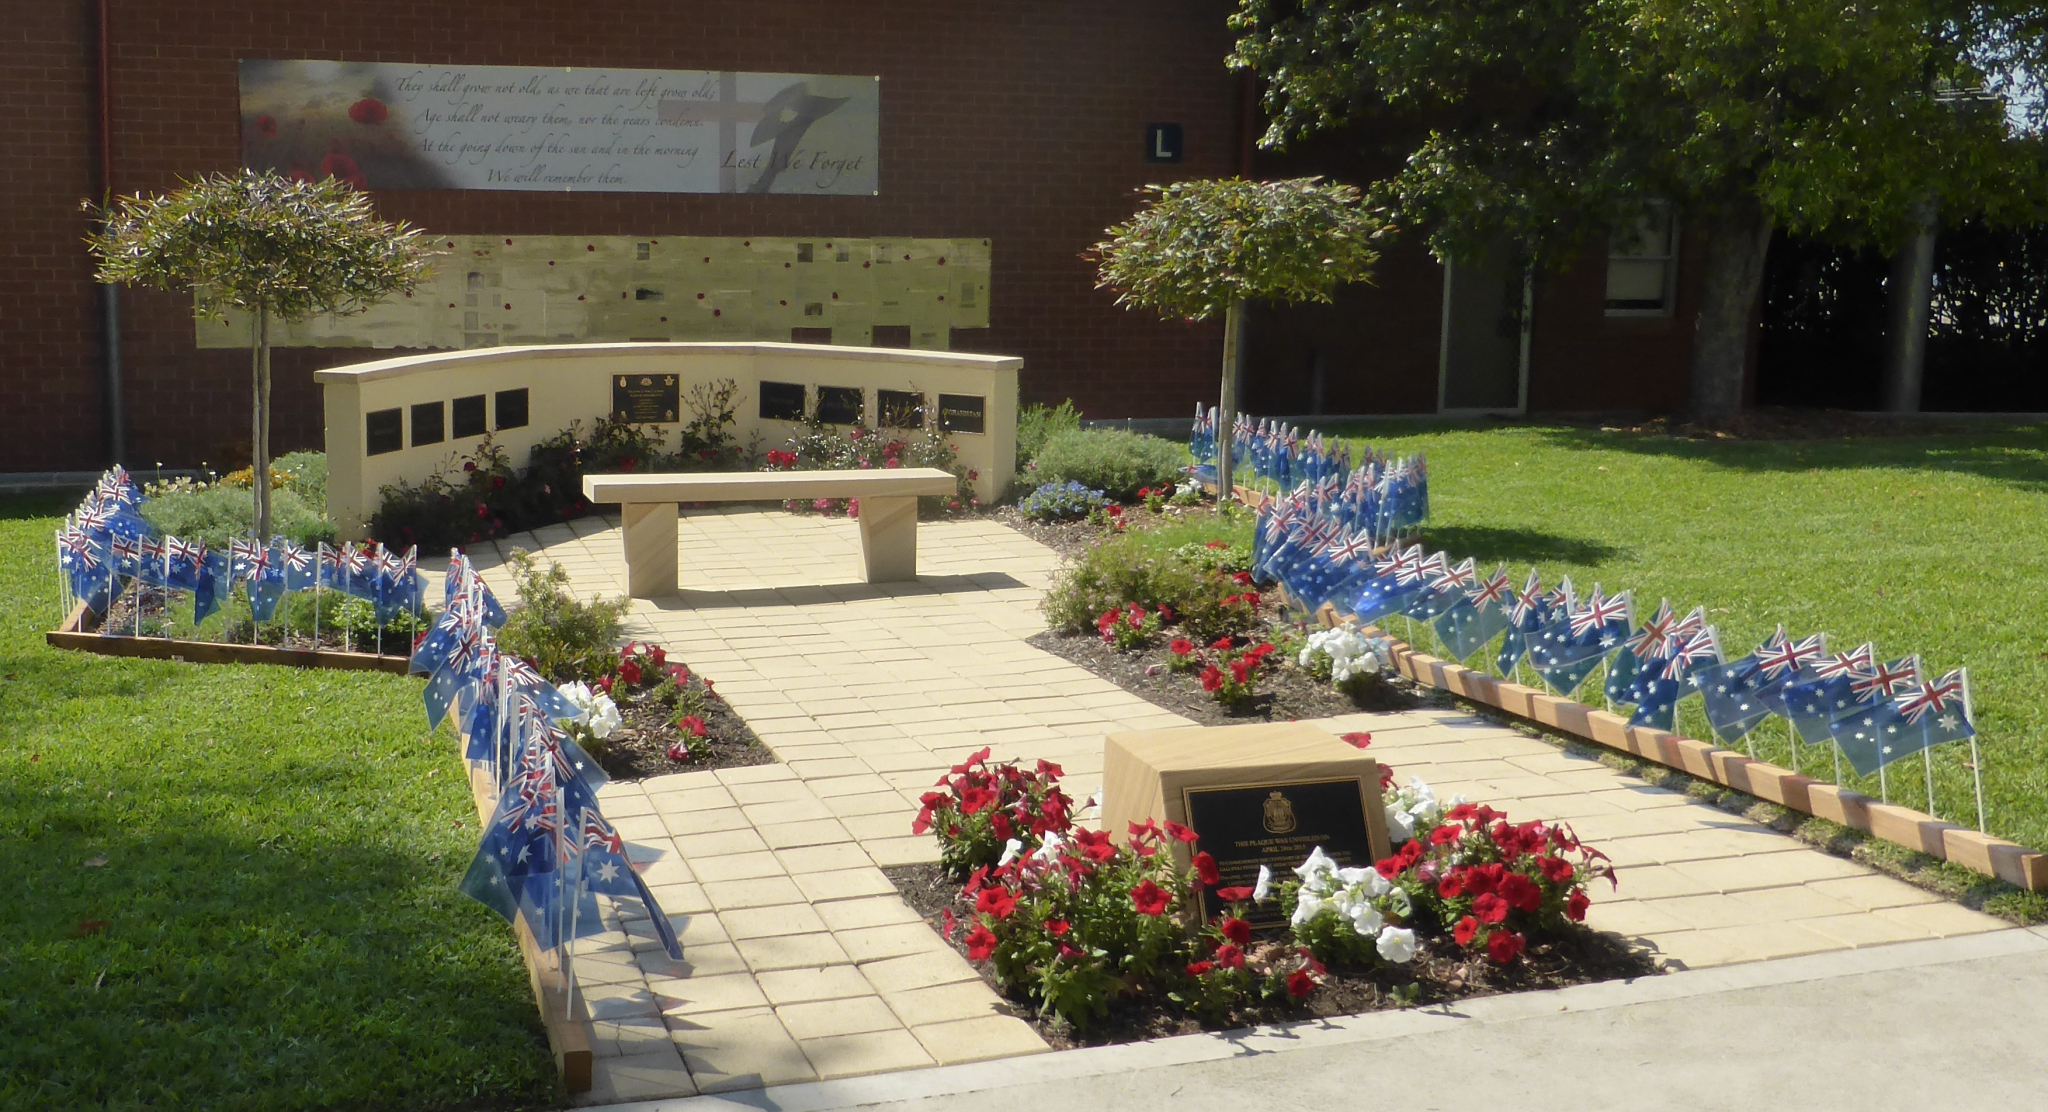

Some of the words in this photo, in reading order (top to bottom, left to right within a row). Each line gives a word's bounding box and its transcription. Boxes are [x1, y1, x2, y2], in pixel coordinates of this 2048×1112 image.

[396, 71, 423, 101] They
[428, 72, 466, 93] shall
[448, 84, 491, 105] grow
[495, 82, 515, 94] not
[519, 75, 547, 96] old,
[547, 86, 560, 95] as
[565, 87, 581, 96] we
[585, 75, 609, 96] that
[613, 87, 632, 96] are
[628, 77, 662, 111] left
[647, 89, 687, 109] grow
[692, 80, 719, 99] old;
[414, 108, 441, 134] Age
[445, 102, 483, 123] shall
[480, 113, 500, 123] not
[542, 103, 572, 126] them,
[578, 117, 597, 125] nor
[601, 105, 624, 125] the
[655, 108, 703, 127] condemn.
[504, 116, 538, 133] weary
[612, 117, 650, 135] years
[417, 138, 434, 151] At
[438, 132, 460, 151] the
[495, 134, 525, 154] down
[519, 133, 554, 167] of
[547, 133, 570, 154] the
[570, 146, 587, 154] sun
[591, 136, 622, 155] and
[617, 145, 628, 155] in
[633, 135, 655, 155] the
[1156, 129, 1172, 157] L
[445, 142, 492, 165] going
[654, 148, 699, 168] morning
[487, 168, 512, 183] We
[514, 164, 546, 183] will
[543, 165, 591, 183] remember
[598, 164, 627, 183] them.
[720, 150, 761, 169] Lest
[770, 150, 804, 170] We
[809, 151, 863, 188] Forget
[1249, 838, 1274, 847] PLAQUE
